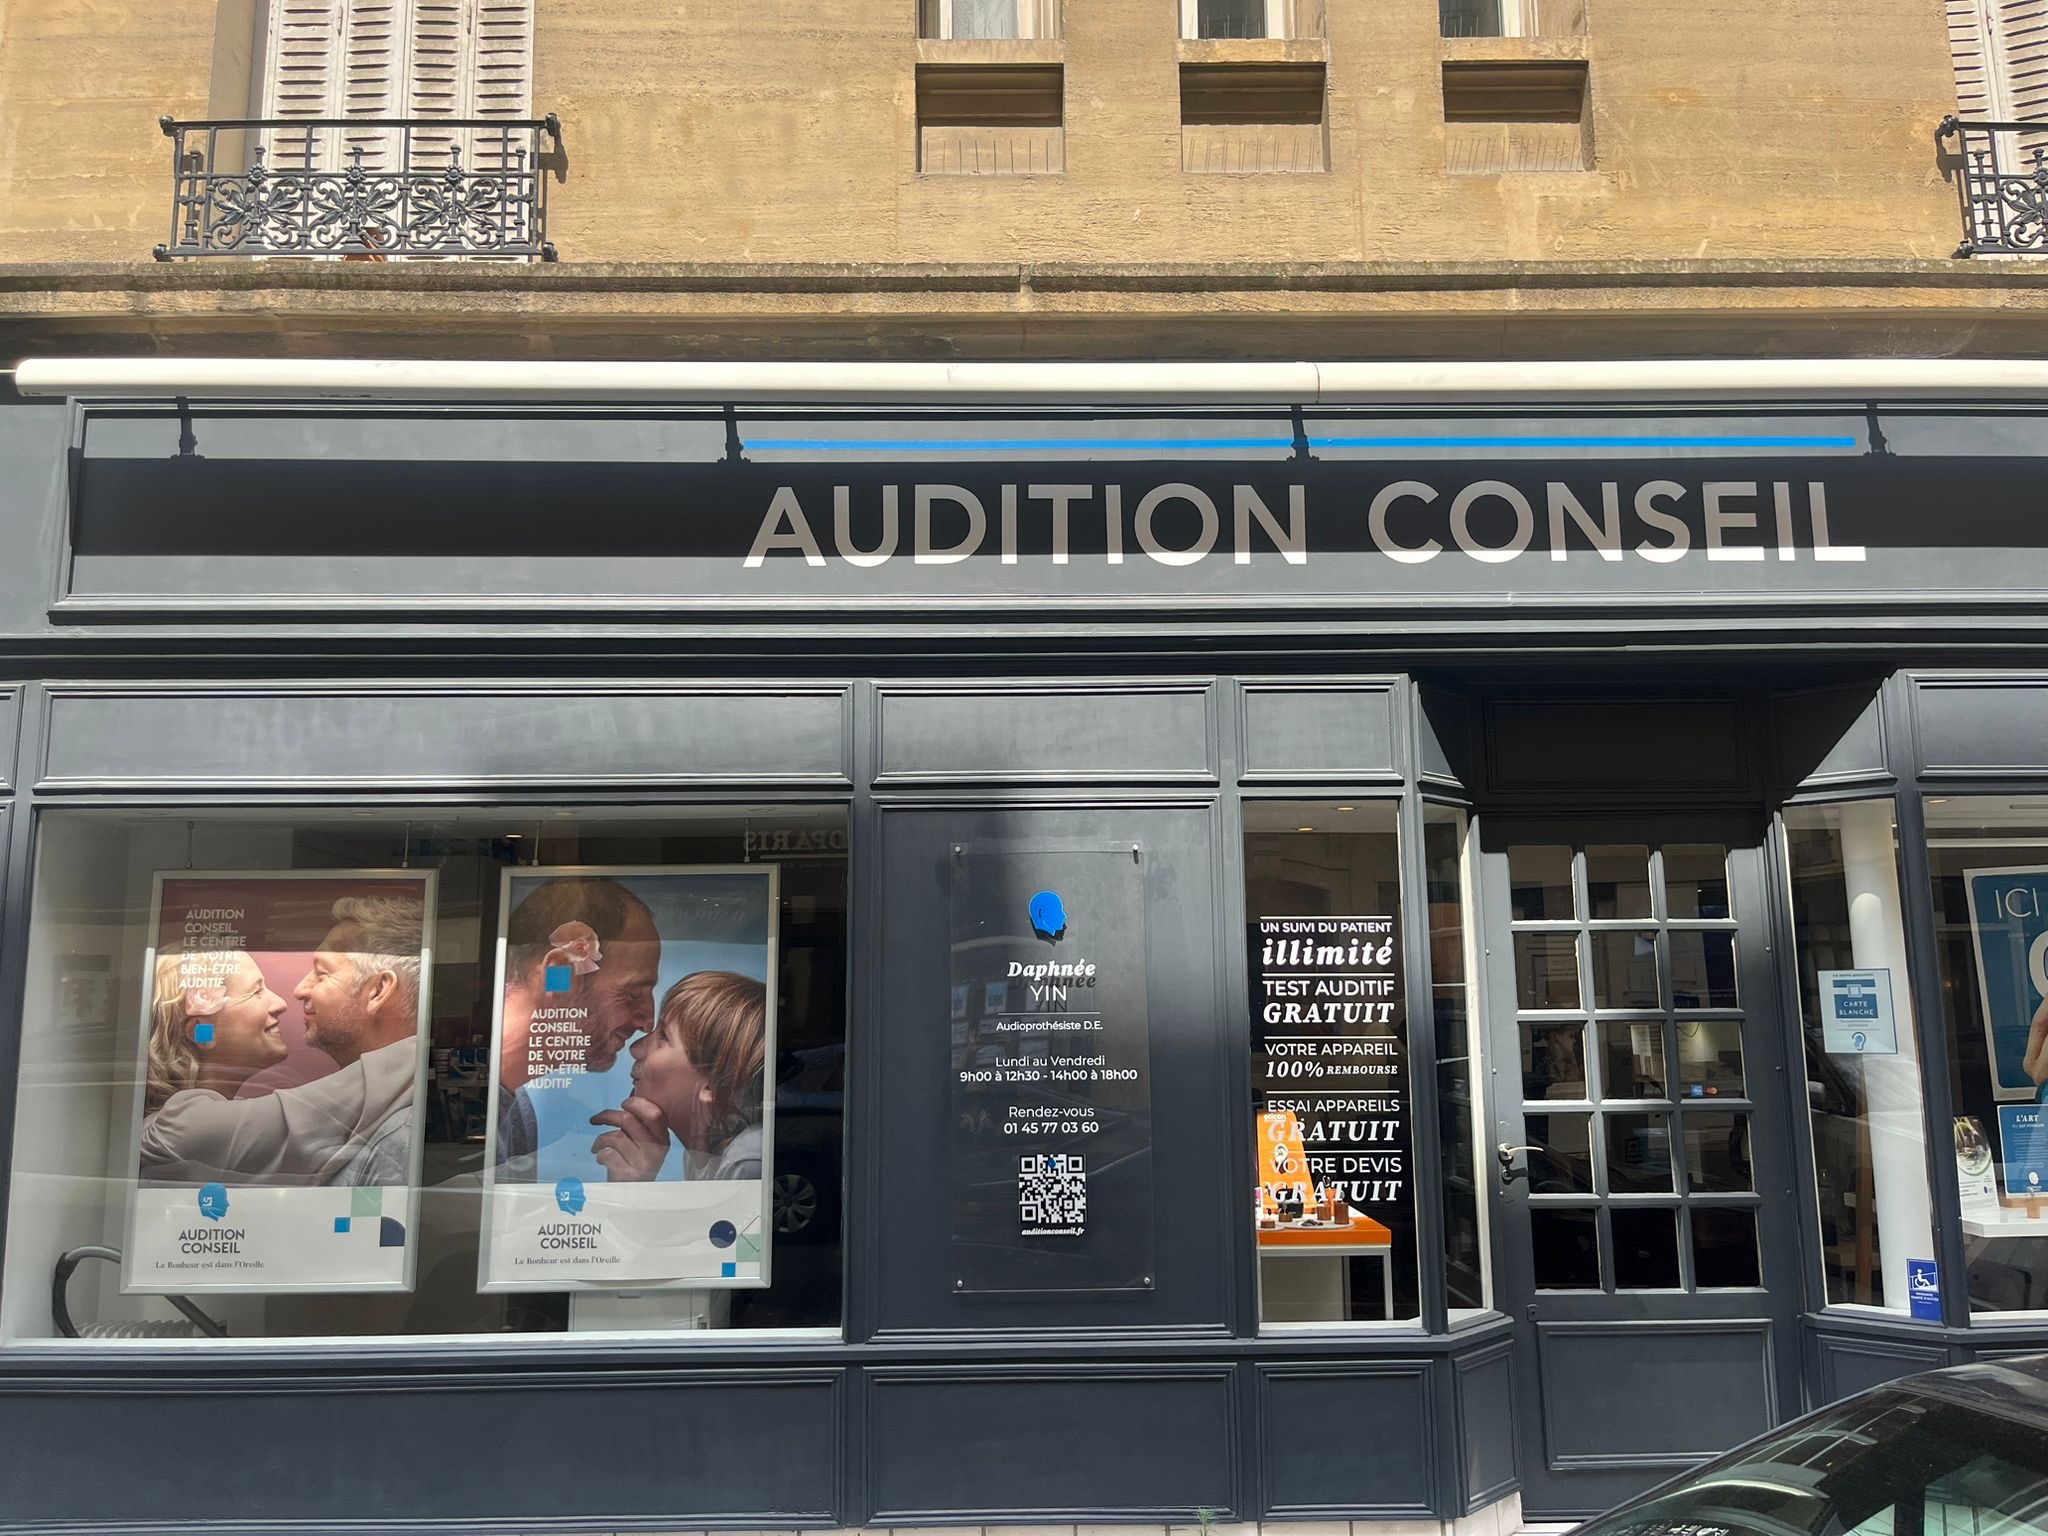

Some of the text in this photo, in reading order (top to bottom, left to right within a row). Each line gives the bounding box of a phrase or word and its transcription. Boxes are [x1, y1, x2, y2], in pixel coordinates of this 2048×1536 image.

[743, 480, 1866, 567] AUDITION CONSEIL
[1995, 887, 2039, 918] ICI
[186, 909, 245, 919] AUDITION
[184, 922, 238, 934] CONSEIL,
[1260, 922, 1392, 933] UN SUIVI DU PATIENT
[183, 936, 247, 947] LE CENTRE
[182, 950, 241, 961] DE VOTRE
[1262, 936, 1393, 965] illimité
[1007, 958, 1096, 981] Daphnée
[179, 977, 225, 989] AUDITIF
[1262, 980, 1395, 996] TEST AUDITIF
[1030, 985, 1067, 1001] YIN
[530, 1008, 588, 1020] AUDITION
[1263, 1002, 1395, 1024] GRATUIT
[529, 1022, 582, 1033] CONSEIL,
[996, 1021, 1103, 1032] Audioprothésiste D.E.
[529, 1035, 591, 1047] LE CENTRE
[528, 1049, 586, 1061] DE VOTRE
[1264, 1043, 1398, 1056] VOTRE APPAREIL
[995, 1055, 1105, 1067] Lundi au Vendredi
[527, 1061, 587, 1075] BIEN-ÊTRE
[1265, 1061, 1398, 1078] 100% REMBOURSE
[960, 1071, 992, 1082] 9h00
[995, 1071, 1002, 1081] à
[1005, 1071, 1040, 1081] 12h30
[1050, 1070, 1088, 1081] 14h00
[1090, 1070, 1098, 1080] à
[1100, 1069, 1138, 1080] 18h00
[528, 1078, 572, 1089] AUDITIF
[1267, 1099, 1400, 1112] ESSAI APPAREILS
[1009, 1106, 1095, 1118] Rendez-vous
[2016, 1114, 2039, 1122] L'ART
[1003, 1122, 1099, 1134] 01 45 77 03 60
[1267, 1120, 1400, 1142] GRATUIT
[1269, 1157, 1402, 1174] VOTRE DEVIS
[1270, 1180, 1402, 1202] GRATUIT
[178, 1229, 245, 1241] AUDITION
[538, 1224, 601, 1236] AUDITION
[181, 1242, 241, 1254] CONSEIL
[540, 1237, 597, 1249] CONSEIL
[155, 1261, 166, 1269] Le
[167, 1261, 199, 1269] Bonheur
[515, 1257, 525, 1265] Le
[527, 1257, 558, 1265] Bonheur
[572, 1256, 589, 1264] dans
